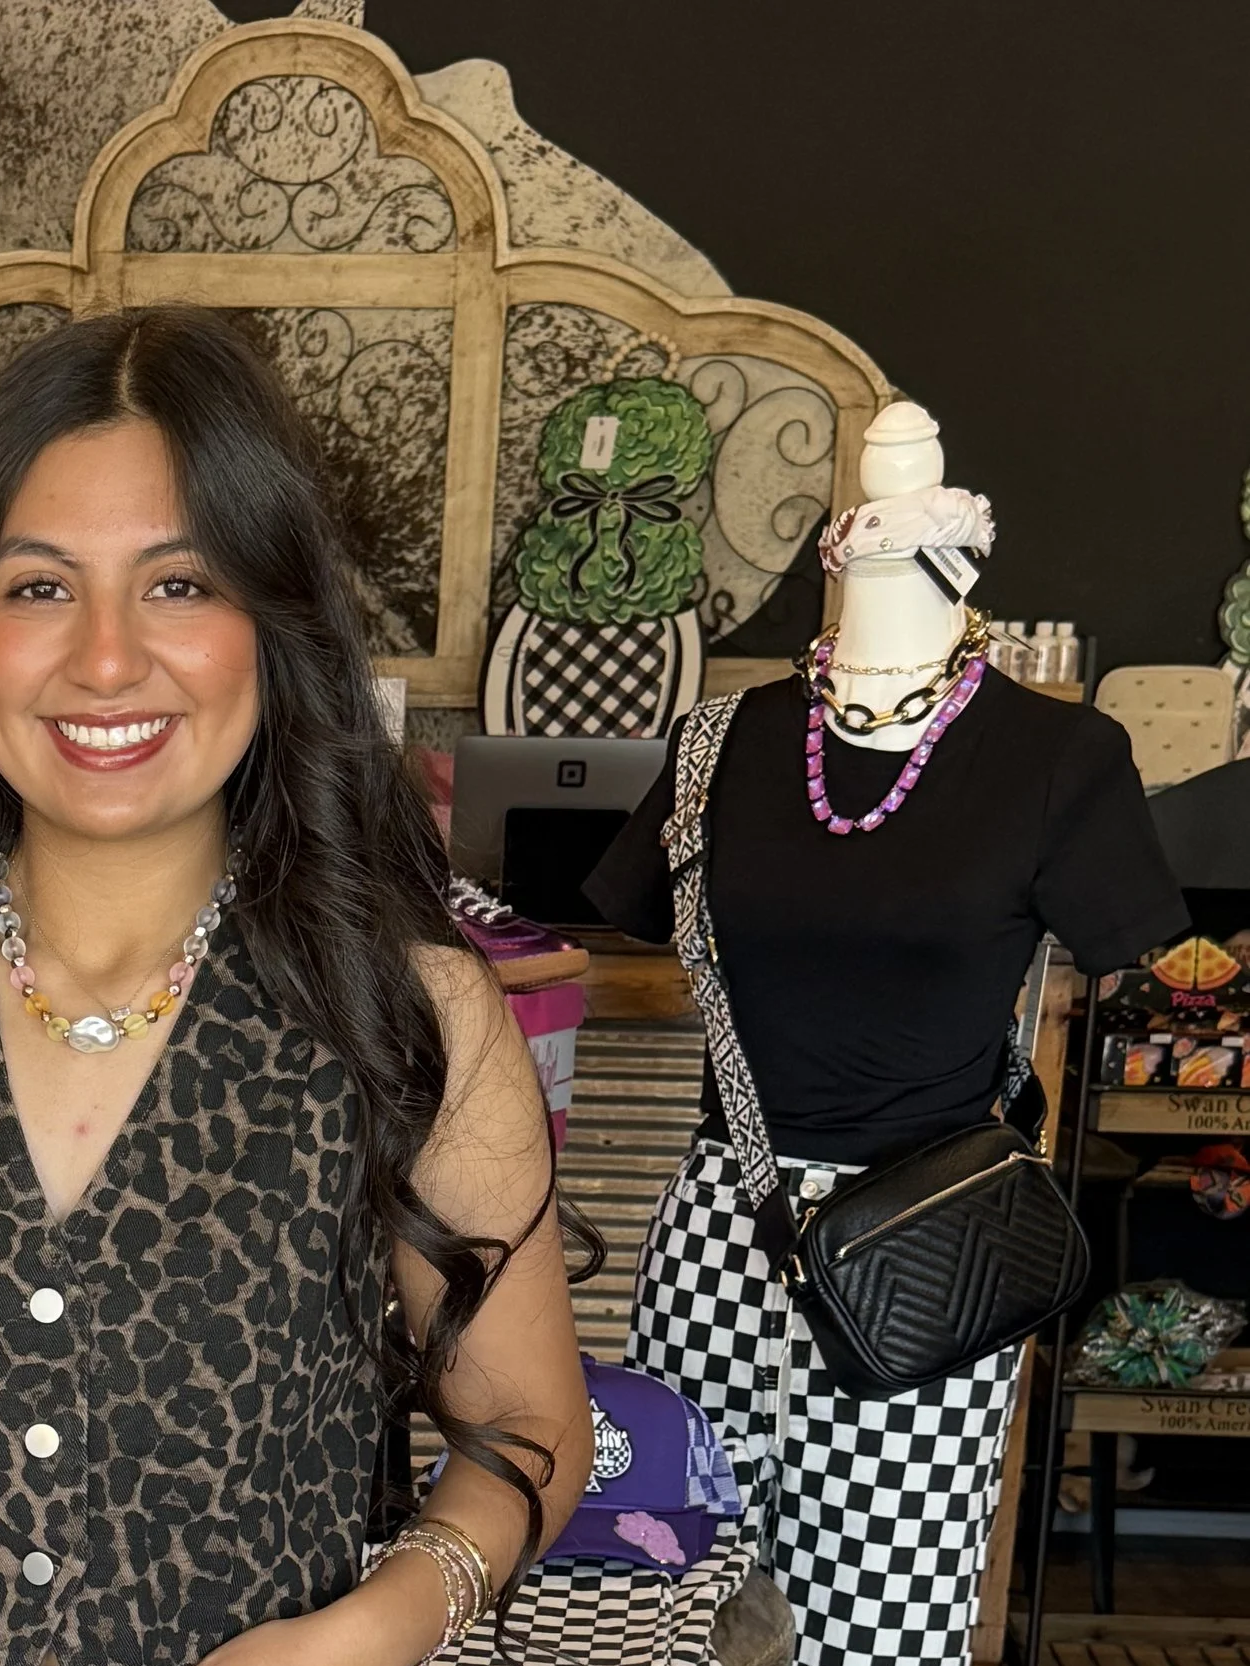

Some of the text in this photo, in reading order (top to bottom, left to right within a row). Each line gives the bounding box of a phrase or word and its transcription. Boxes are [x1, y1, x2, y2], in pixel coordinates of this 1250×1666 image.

[1167, 1094, 1228, 1113] Swan
[1187, 1115, 1229, 1130] 100%
[1140, 1396, 1250, 1417] Swan Cre
